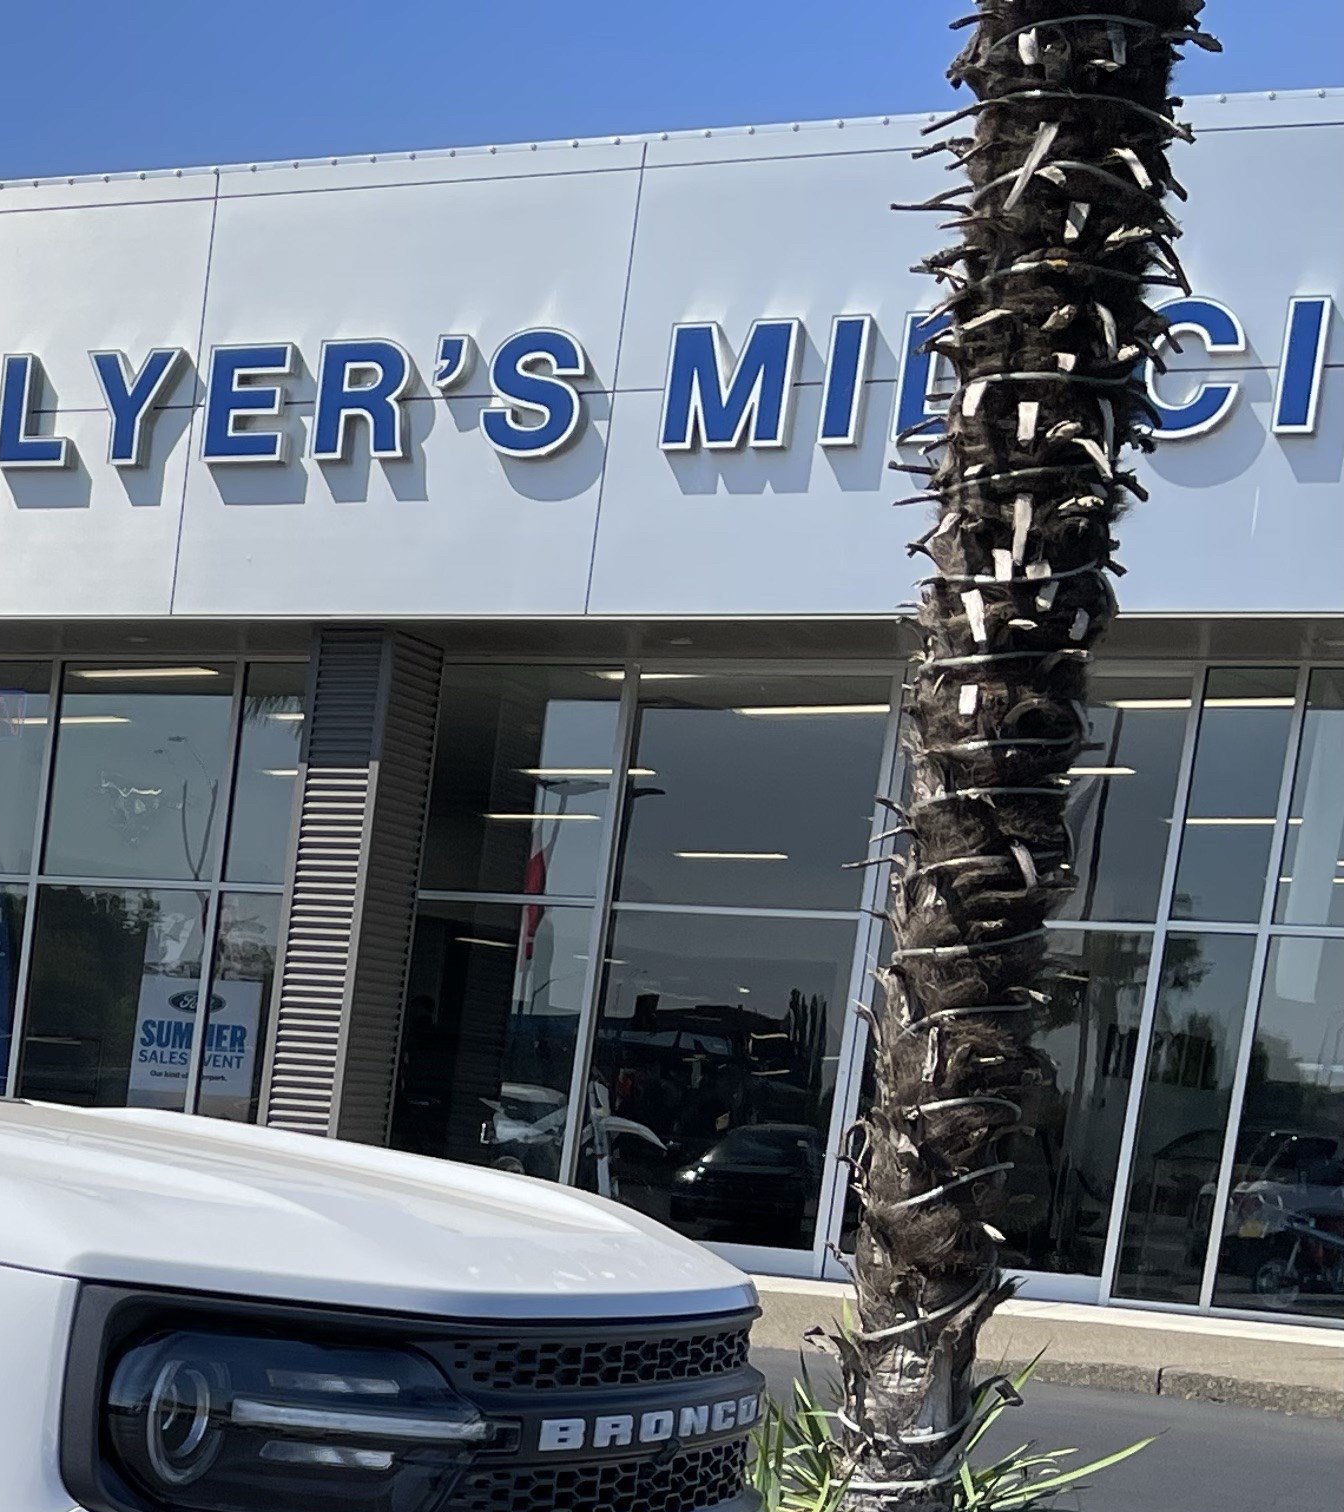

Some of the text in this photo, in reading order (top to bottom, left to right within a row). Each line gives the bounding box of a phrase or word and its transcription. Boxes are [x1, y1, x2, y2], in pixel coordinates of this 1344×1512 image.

[139, 1049, 244, 1069] SALES VENT
[538, 1394, 759, 1451] BRONCO
